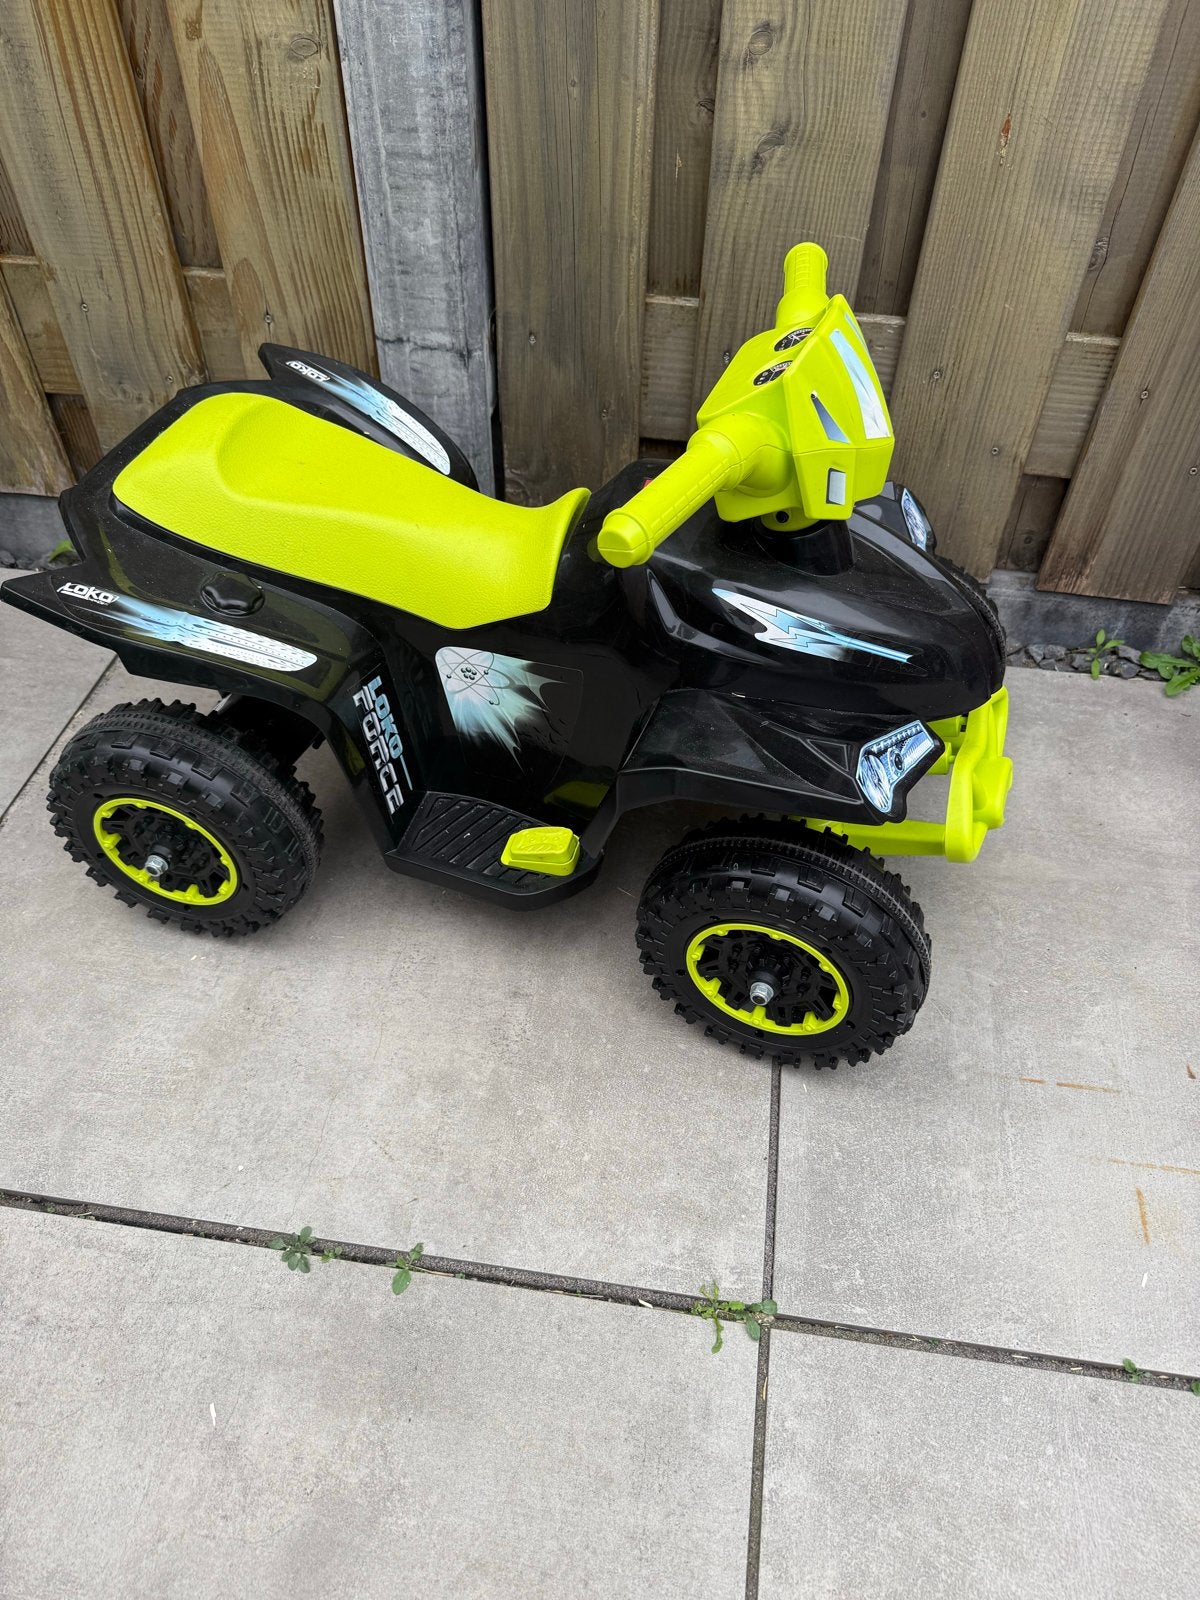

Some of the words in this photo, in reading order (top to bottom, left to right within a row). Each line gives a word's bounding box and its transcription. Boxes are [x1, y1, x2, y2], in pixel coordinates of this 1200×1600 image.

[58, 582, 118, 604] LOKO
[352, 685, 404, 815] FORCE
[367, 675, 403, 760] LOKO
